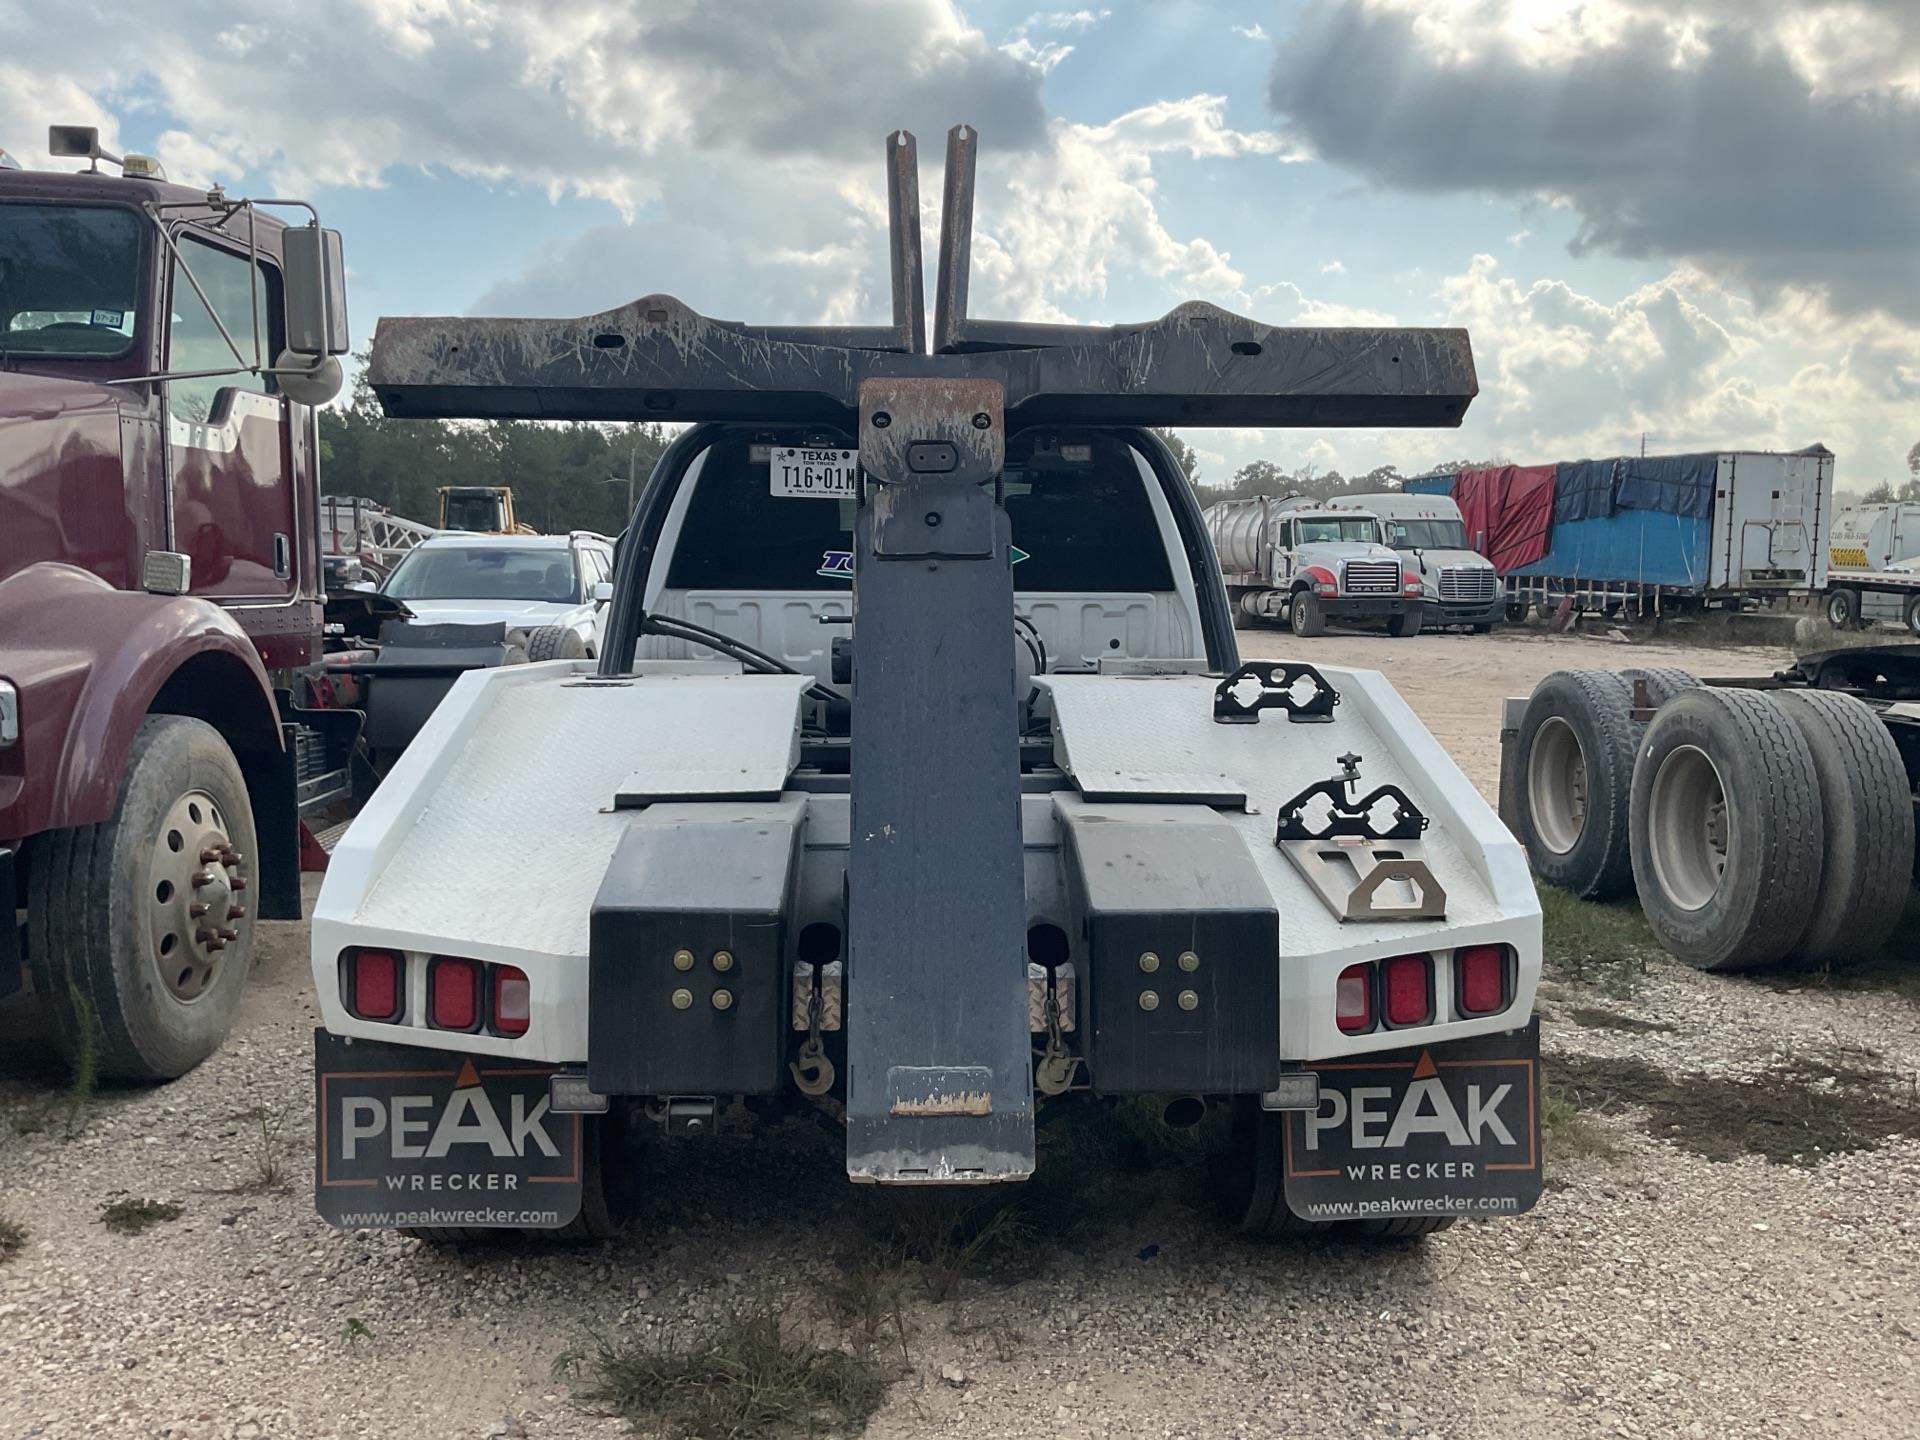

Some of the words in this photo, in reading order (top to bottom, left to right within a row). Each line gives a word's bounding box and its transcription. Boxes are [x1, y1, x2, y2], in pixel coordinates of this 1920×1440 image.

[801, 451, 837, 461] TEXAS
[341, 1057, 562, 1159] PEAK
[1305, 1050, 1517, 1150] PEAK
[1347, 1162, 1475, 1181] WRECKER
[386, 1173, 519, 1191] WRECKER
[1308, 1195, 1518, 1217] www.peakwrecker.com
[341, 1207, 558, 1226] www.peakwrecker.com
